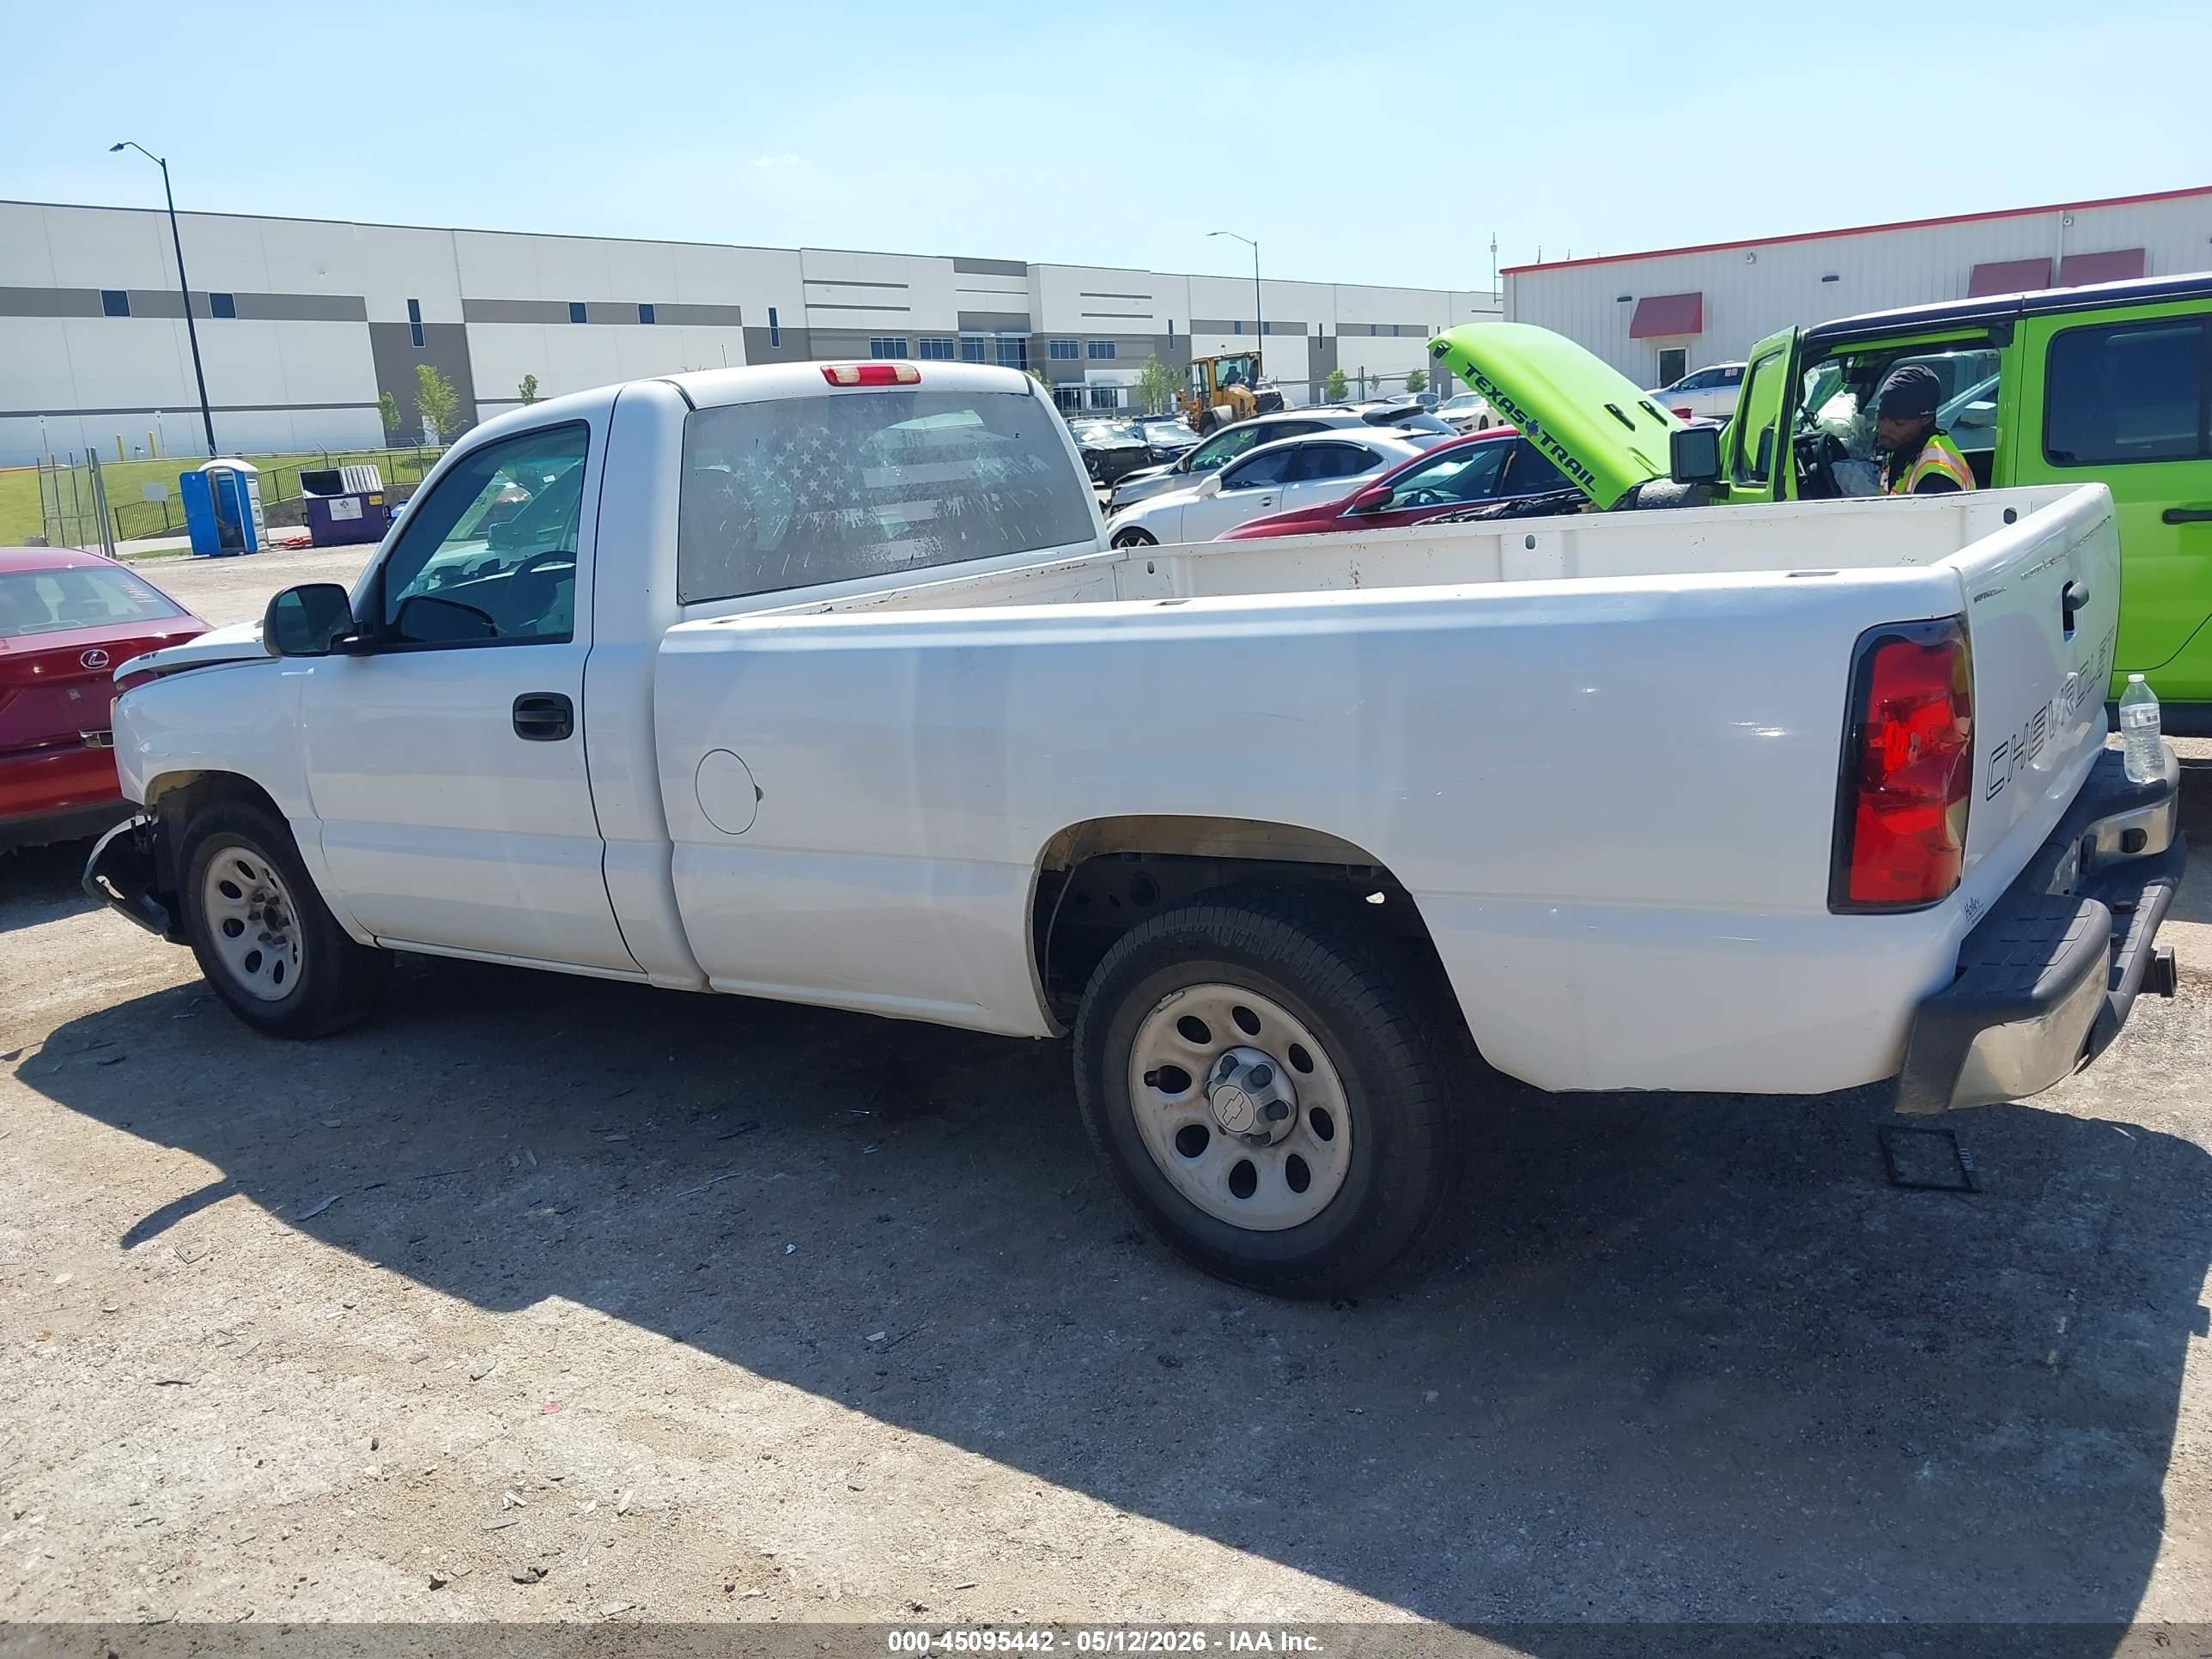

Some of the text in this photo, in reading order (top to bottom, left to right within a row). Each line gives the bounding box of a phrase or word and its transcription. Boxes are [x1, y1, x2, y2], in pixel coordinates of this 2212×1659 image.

[1464, 362, 1596, 493] TEXAS TRAIL
[1986, 625, 2115, 801] CHEVROLET
